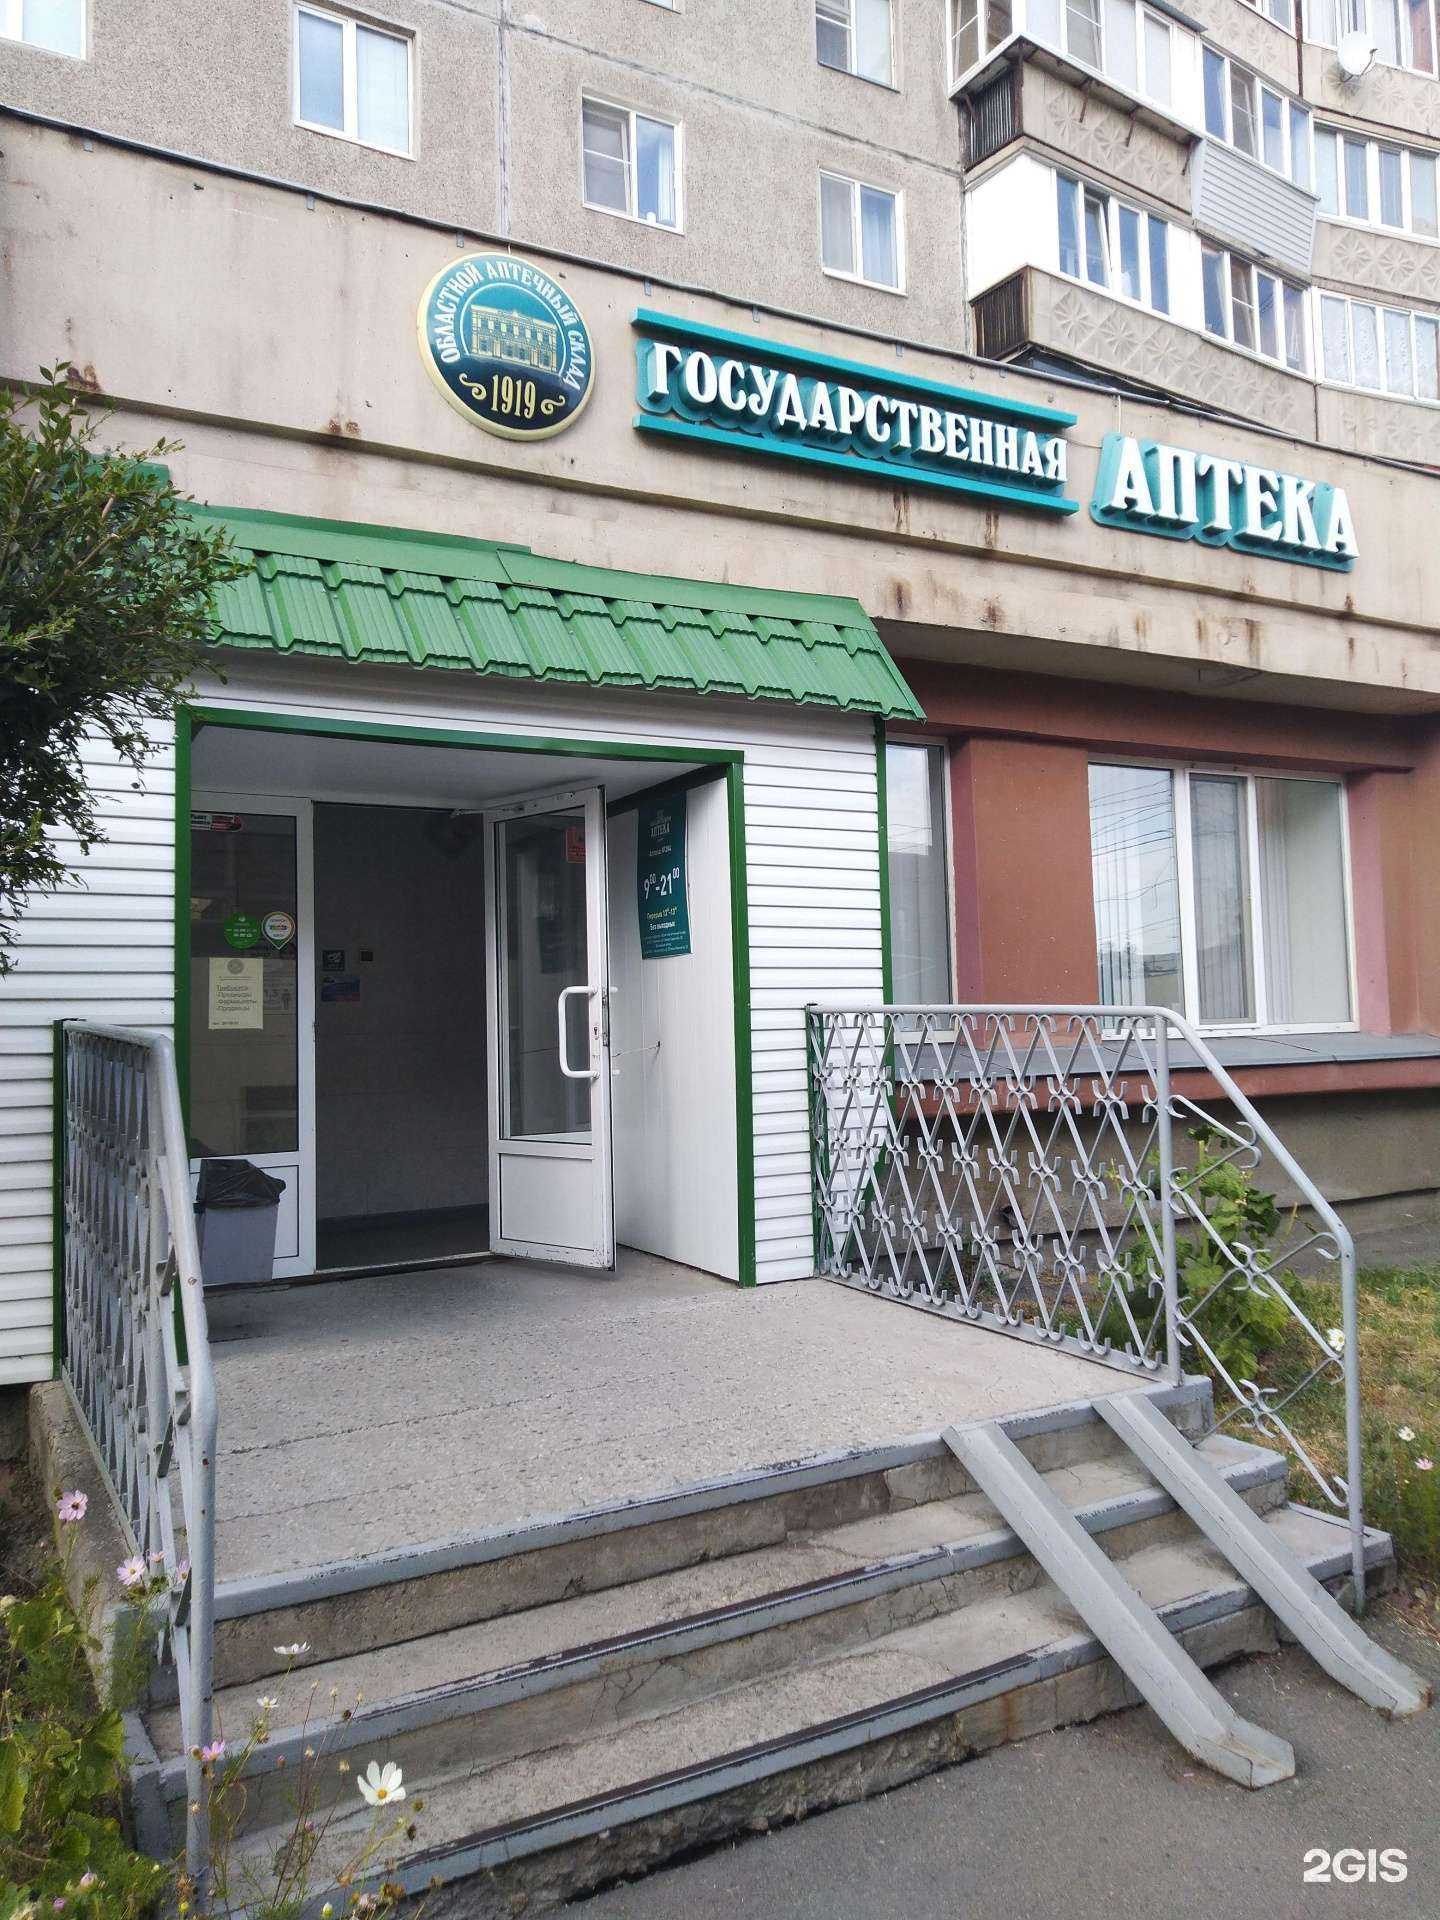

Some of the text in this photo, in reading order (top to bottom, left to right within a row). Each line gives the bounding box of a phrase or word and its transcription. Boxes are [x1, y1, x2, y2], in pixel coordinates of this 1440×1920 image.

[434, 260, 588, 392] ОБЛАСТНОЙ АПТЕЧНЫЙ СКЛАД
[490, 374, 537, 420] 1919
[647, 342, 1068, 483] ГОСУДАРСТВЕННАЯ
[1101, 436, 1361, 561] АПТЕКА
